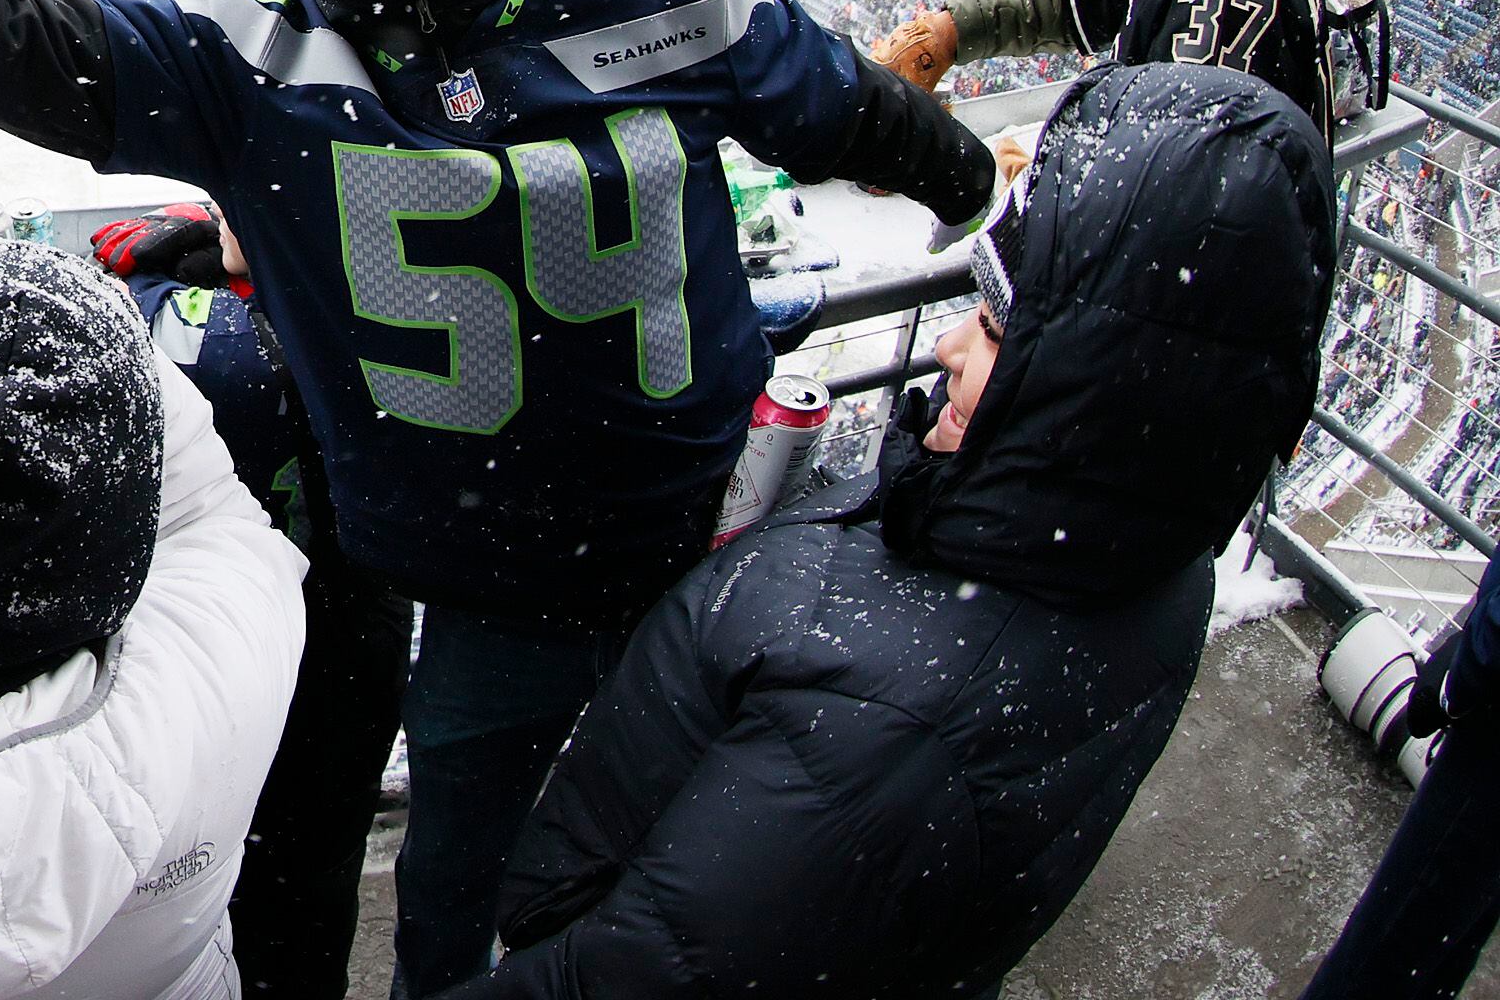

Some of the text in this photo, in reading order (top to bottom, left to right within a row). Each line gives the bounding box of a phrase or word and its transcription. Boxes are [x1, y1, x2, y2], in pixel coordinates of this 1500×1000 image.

[592, 26, 707, 69] SEAHAWKS
[448, 90, 479, 115] NFL
[330, 105, 693, 435] 54
[710, 559, 753, 613] Columbia
[135, 858, 198, 895] NORTH
[162, 849, 197, 874] THE
[153, 868, 198, 897] FACE
